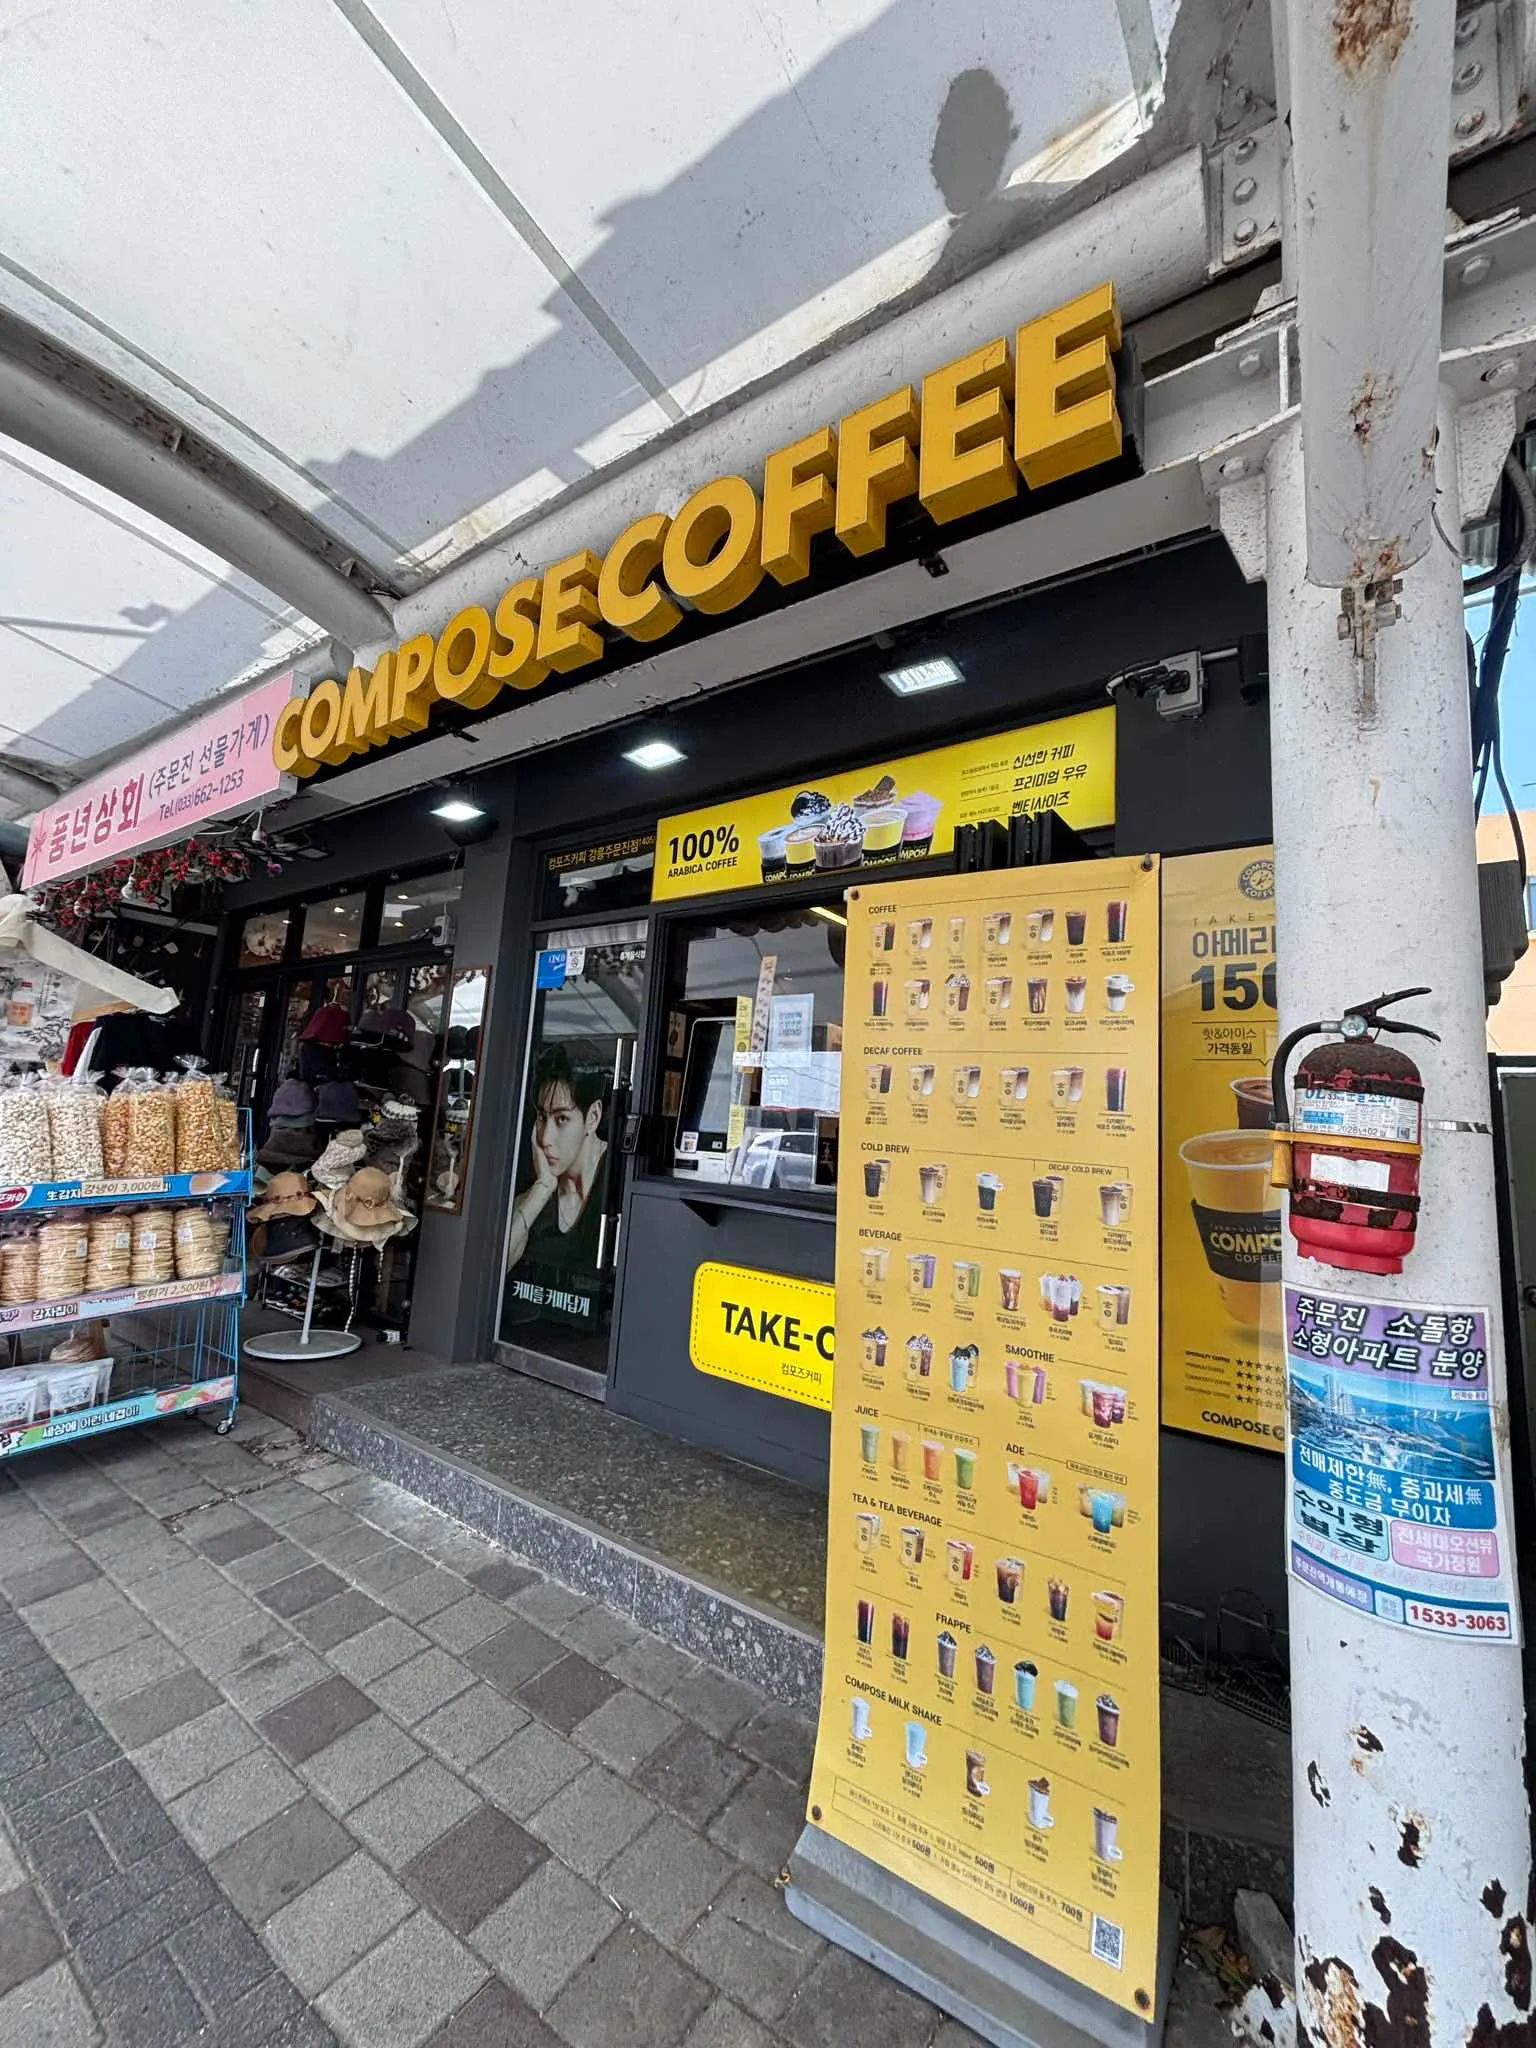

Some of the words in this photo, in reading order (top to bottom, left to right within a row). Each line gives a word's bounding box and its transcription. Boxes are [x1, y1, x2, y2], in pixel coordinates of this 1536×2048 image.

[149, 751, 194, 799] (주문진
[200, 713, 270, 776] 선물가게)
[1013, 749, 1048, 770] 신선한
[1051, 743, 1075, 761] 커피
[1012, 769, 1060, 792] 프리미엄
[1062, 763, 1087, 781] 우유
[1012, 790, 1070, 814] 벤티사이즈
[49, 773, 145, 864] 풍년상회
[669, 824, 739, 865] 100%
[548, 849, 587, 871] 컴포즈커피
[667, 863, 703, 879] ARABICA
[705, 856, 737, 871] COFFEE
[868, 904, 897, 914] COFFEE
[1203, 1027, 1257, 1041] 핫&아이스
[863, 1047, 891, 1056] DECAF
[892, 1047, 923, 1056] COFFEE
[1208, 1042, 1253, 1056] 가격동일
[861, 1142, 883, 1152] COLD
[885, 1144, 910, 1155] BREW
[859, 1228, 903, 1242] BEVERAGE
[512, 1280, 544, 1305] 커피를
[544, 1288, 590, 1317] 커피답게
[1296, 1297, 1367, 1333] 주문진
[1384, 1313, 1474, 1346] 소돌항
[1005, 1344, 1056, 1363] SMOOTHIE
[1292, 1327, 1420, 1371] 소형아파트
[1431, 1348, 1485, 1379] 분양
[781, 1363, 822, 1385] 컴포즈커피
[854, 1405, 879, 1418] JUICE
[1201, 1410, 1271, 1436] COMPOSE
[42, 1420, 77, 1439] 세상에
[1006, 1442, 1025, 1456] ADE
[1328, 1480, 1383, 1513] 중도금
[1391, 1500, 1452, 1526] 무이자
[1401, 1477, 1482, 1506] 중과세無
[852, 1492, 869, 1504] TEA
[870, 1497, 877, 1507] &
[878, 1500, 895, 1513] TEA
[896, 1505, 943, 1527] BEVERAGE
[935, 1612, 972, 1634] FRAPPE
[1409, 1605, 1506, 1631] 1533-3063
[845, 1674, 887, 1702] COMPOSE
[888, 1694, 911, 1711] MILK
[911, 1703, 943, 1727] SHAKE
